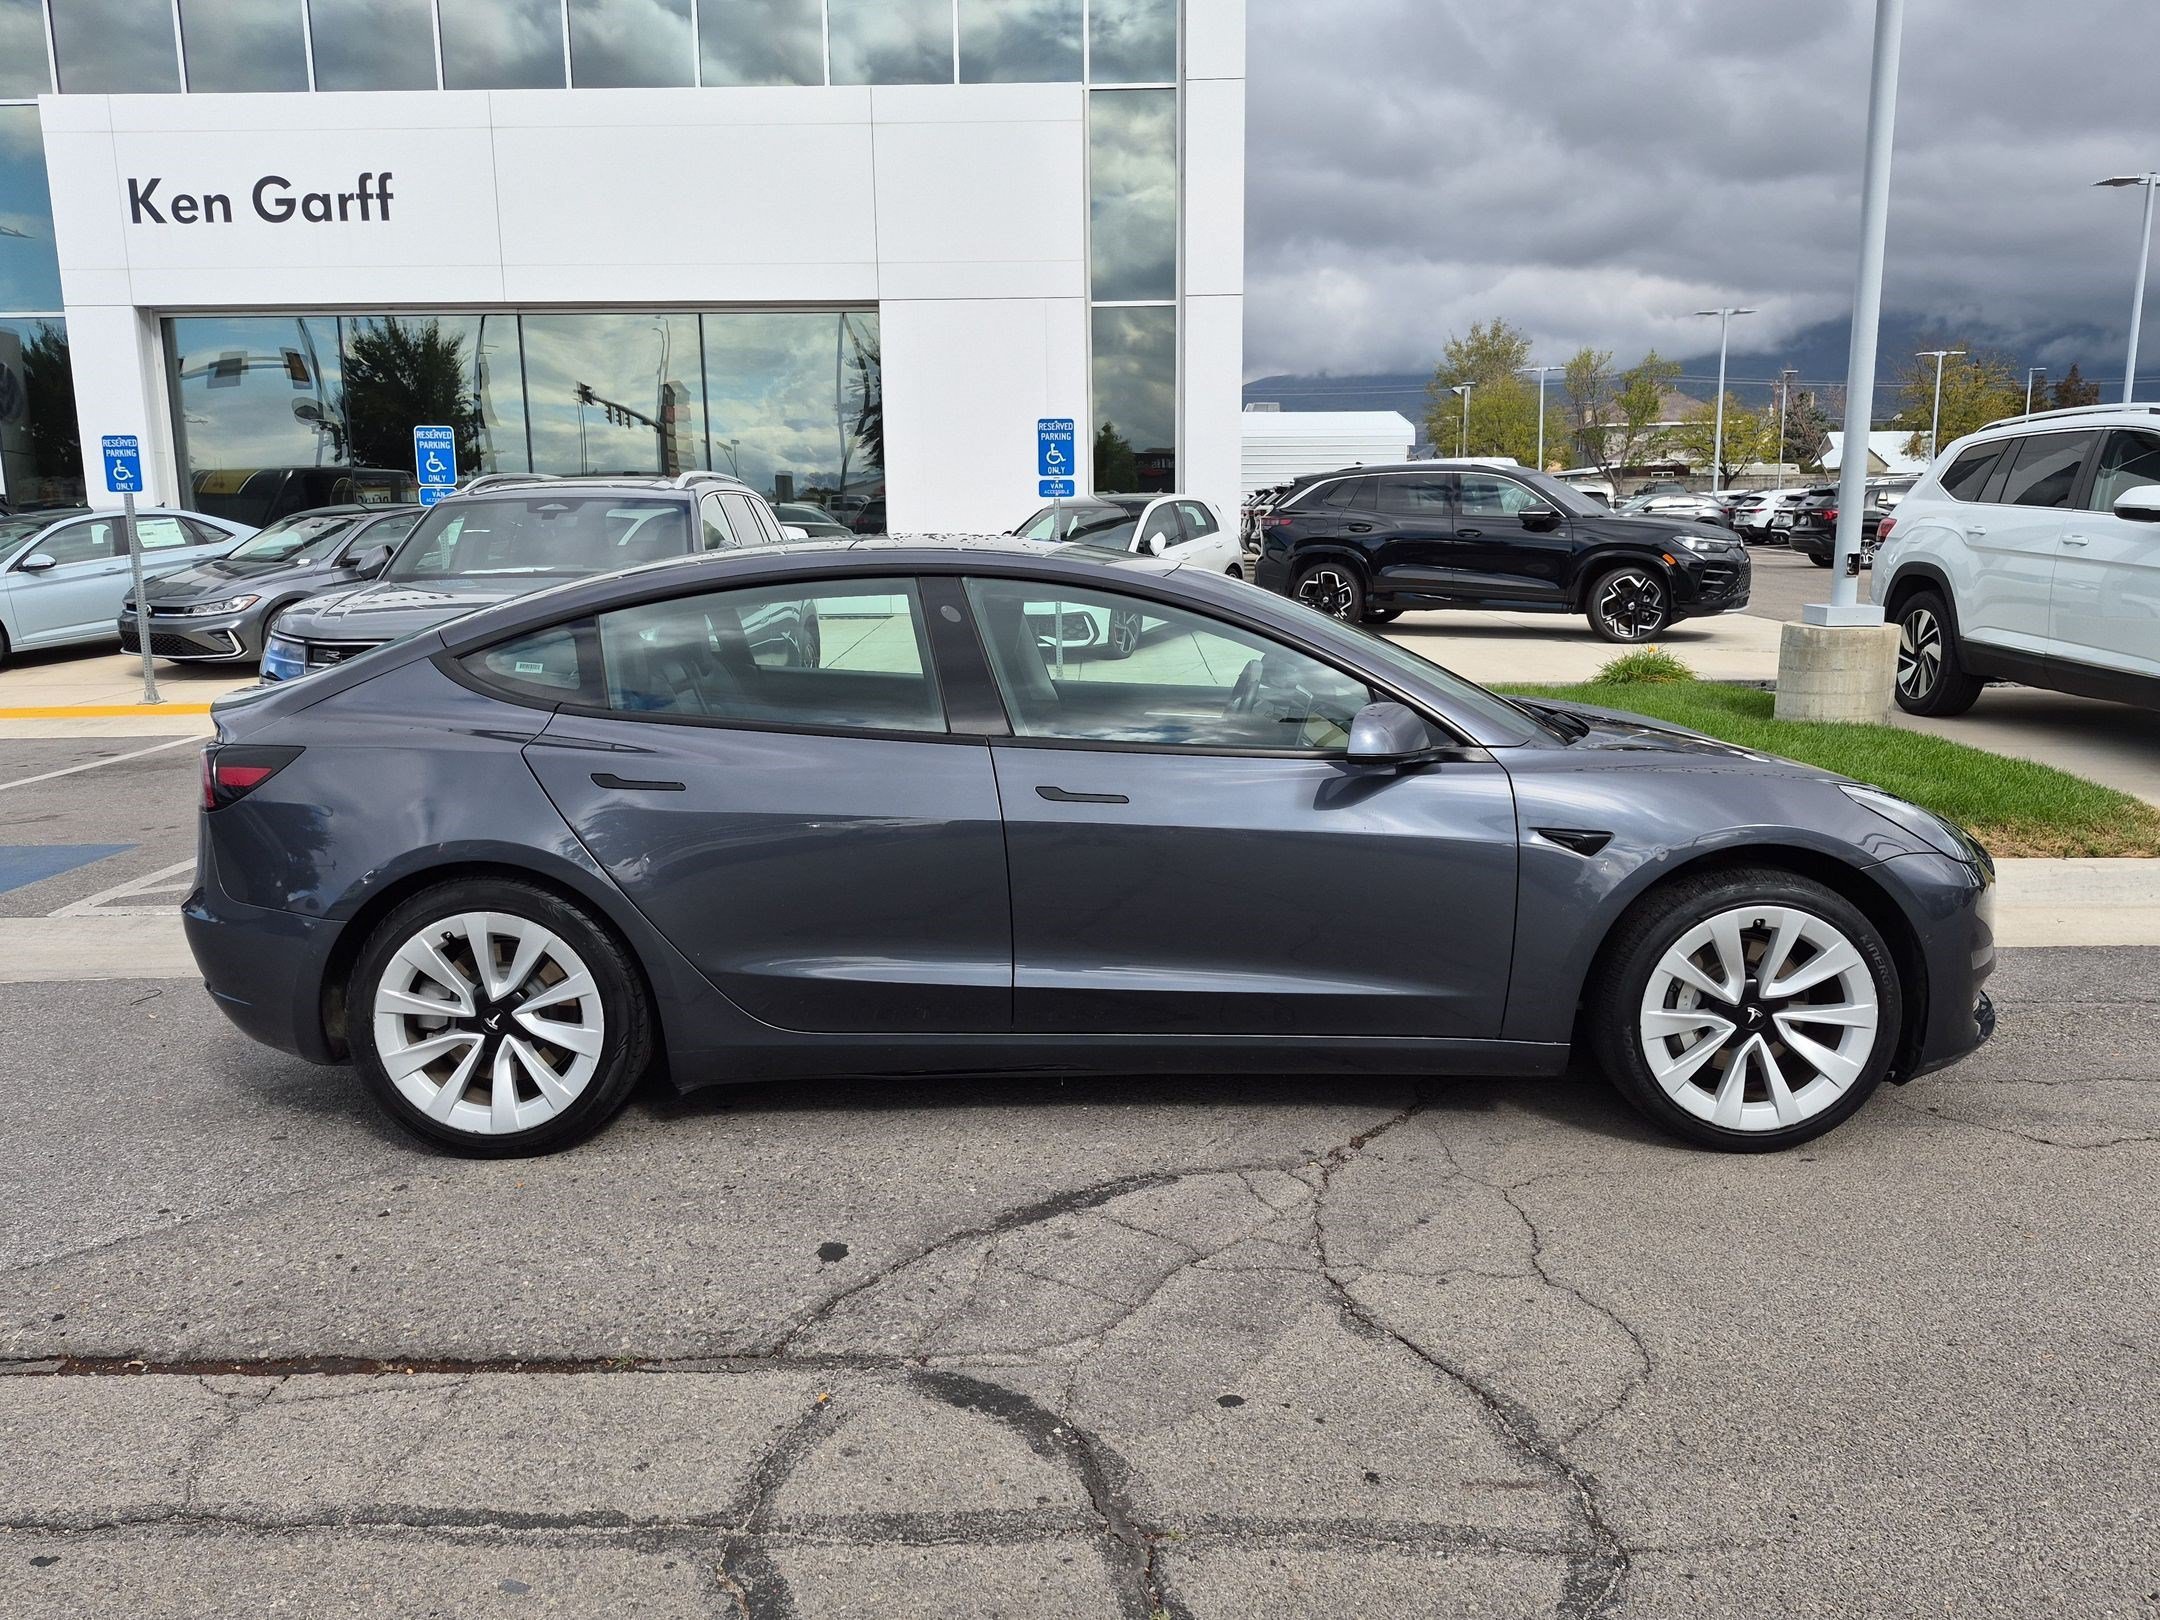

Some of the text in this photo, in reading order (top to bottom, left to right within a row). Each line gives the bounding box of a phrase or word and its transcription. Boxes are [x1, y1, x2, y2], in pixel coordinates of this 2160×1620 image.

[127, 172, 394, 224] Ken Garff
[1038, 422, 1074, 431] RESERVED
[416, 430, 452, 440] RESERVED
[1041, 432, 1072, 441] PARKING
[102, 439, 137, 448] RESERVED
[419, 441, 451, 450] PARKING
[105, 449, 137, 457] PARKING
[1047, 466, 1066, 475] ONLY
[428, 474, 446, 483] ONLY
[115, 482, 134, 490] ONLY
[431, 490, 446, 498] VAN
